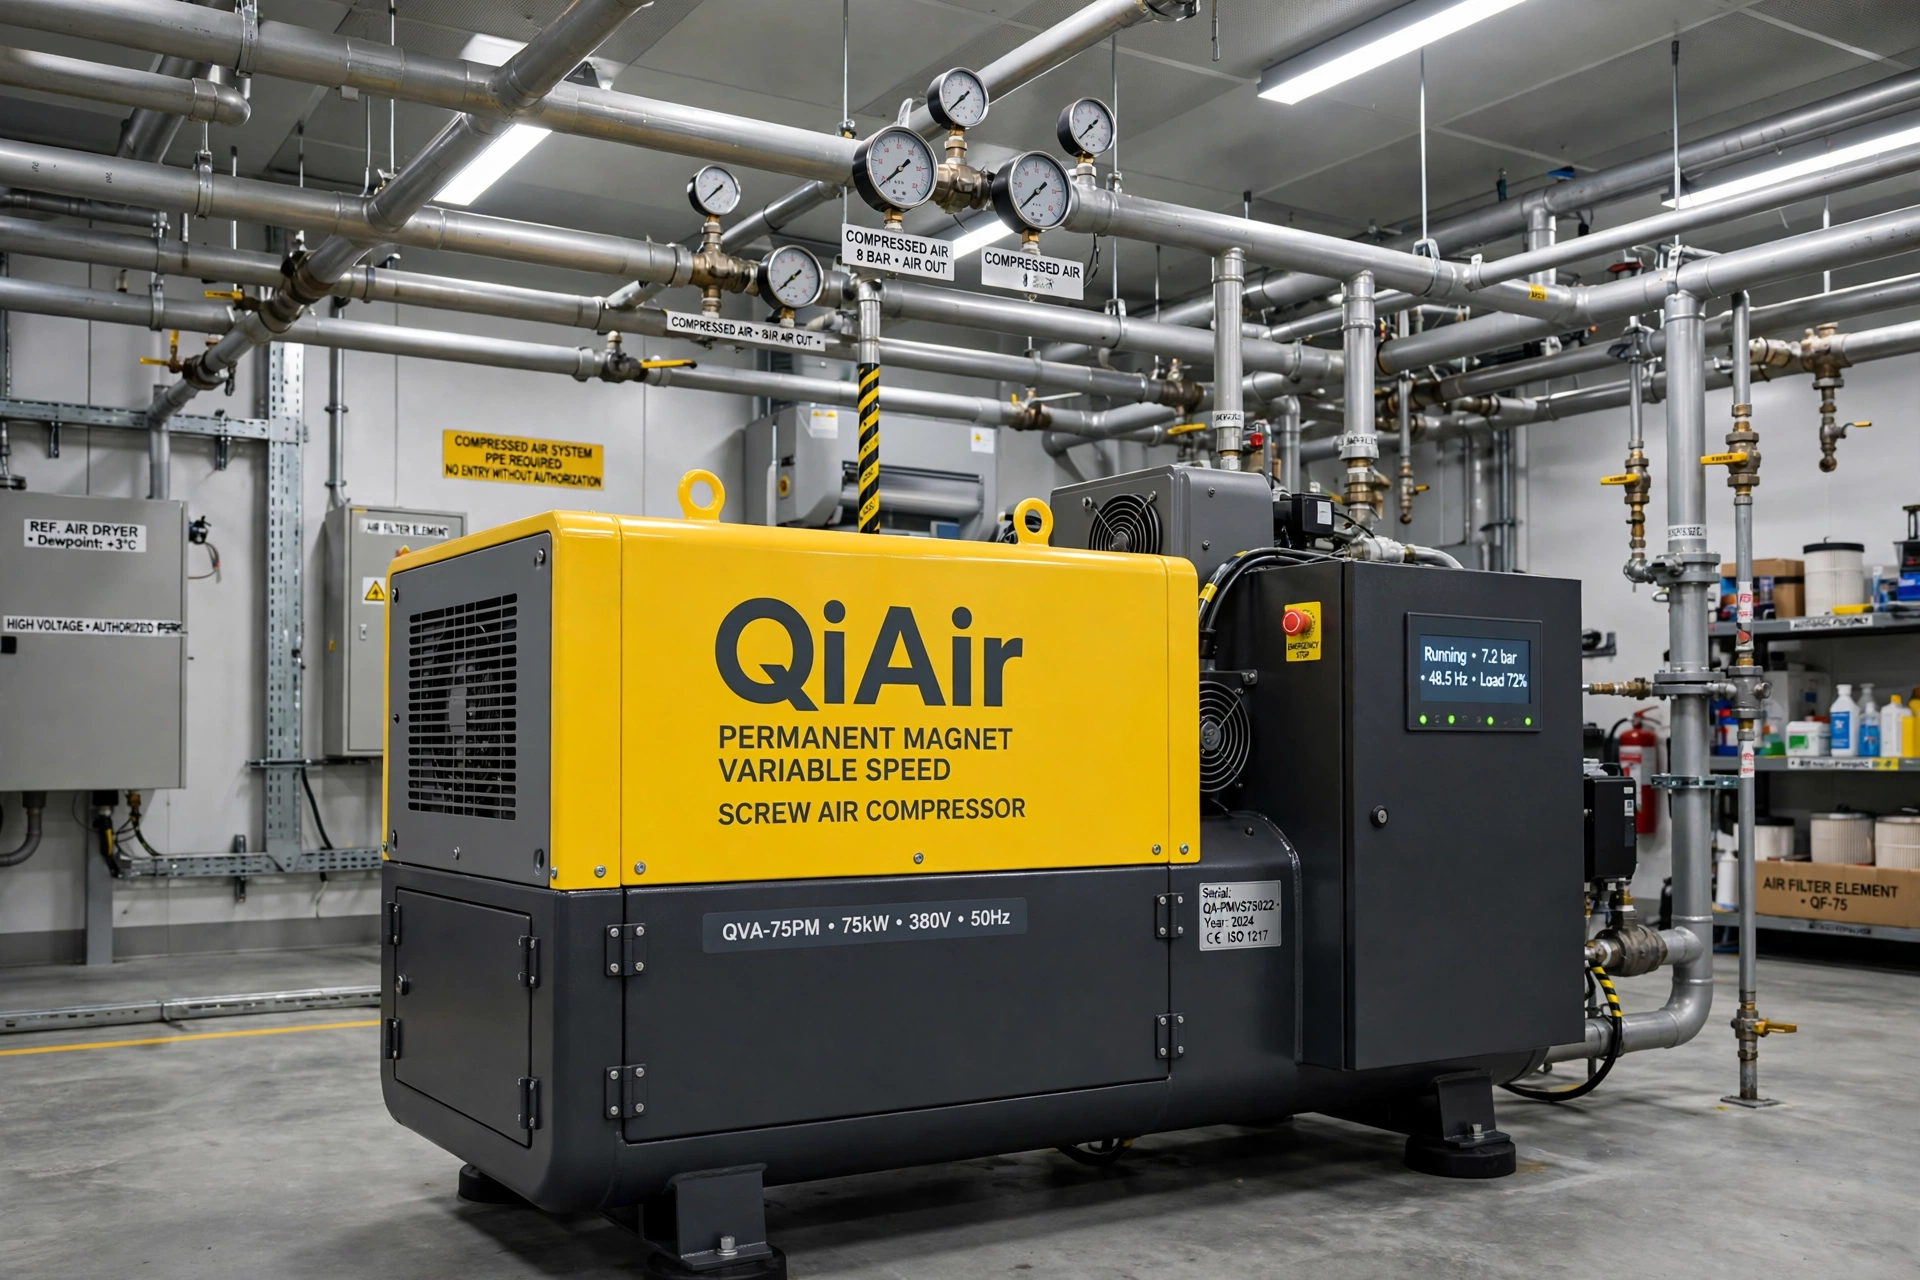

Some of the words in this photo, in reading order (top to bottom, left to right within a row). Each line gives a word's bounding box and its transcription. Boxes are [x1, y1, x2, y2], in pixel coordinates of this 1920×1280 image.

[846, 230, 927, 254] COMPRESSED
[930, 244, 949, 258] AIR
[857, 249, 863, 261] 8
[867, 250, 891, 265] BAR
[903, 257, 922, 270] AIR
[924, 260, 947, 274] OUT
[984, 251, 1060, 275] COMPRESSED
[1062, 265, 1081, 278] AIR
[671, 316, 736, 335] COMPRESSED
[738, 326, 753, 338] AIR
[454, 435, 528, 453] COMPRESSED
[531, 443, 548, 455] AIR
[551, 444, 593, 459] SYSTEM
[485, 452, 505, 465] PPE
[509, 454, 563, 470] REQUIRED
[445, 464, 458, 475] NO
[461, 465, 489, 479] ENTRY
[492, 468, 533, 483] WITHOUT
[534, 470, 601, 488] AUTHORIZATION
[30, 521, 60, 534] REF.
[64, 523, 88, 535] AIR
[92, 524, 138, 538] DRYER
[7, 618, 34, 630] HIGH
[36, 619, 84, 632] VOLTAGE
[714, 597, 1024, 711] QiAir
[1424, 646, 1467, 666] Running
[1481, 648, 1498, 664] 7.2
[1500, 649, 1518, 665] bar
[1428, 670, 1452, 686] 48.5
[1454, 671, 1468, 686] Hz
[1480, 672, 1505, 687] Load
[1507, 673, 1528, 688] 72%
[719, 725, 895, 750] PERMANENT
[904, 727, 1013, 750] MAGNET
[718, 758, 858, 783] VARIABLE
[865, 758, 951, 782] SPEED
[718, 801, 811, 826] SCREW
[817, 800, 859, 823] AIR
[866, 797, 1026, 822] COMPRESSOR
[1202, 886, 1232, 899] Serial:
[1763, 877, 1785, 891] AIR
[1788, 879, 1831, 894] FILTER
[1835, 882, 1899, 898] ELEMENT
[1203, 899, 1275, 915] QA-PMVS75022
[1810, 896, 1848, 911] QF-75
[722, 918, 820, 942] QVA-75PM
[841, 914, 890, 934] 75kW
[908, 911, 952, 931] 380V
[970, 909, 1011, 927] 50Hz
[1204, 917, 1229, 929] Year:
[1231, 915, 1255, 928] 2024
[1228, 930, 1245, 943] ISO
[1247, 929, 1269, 942] 1217
